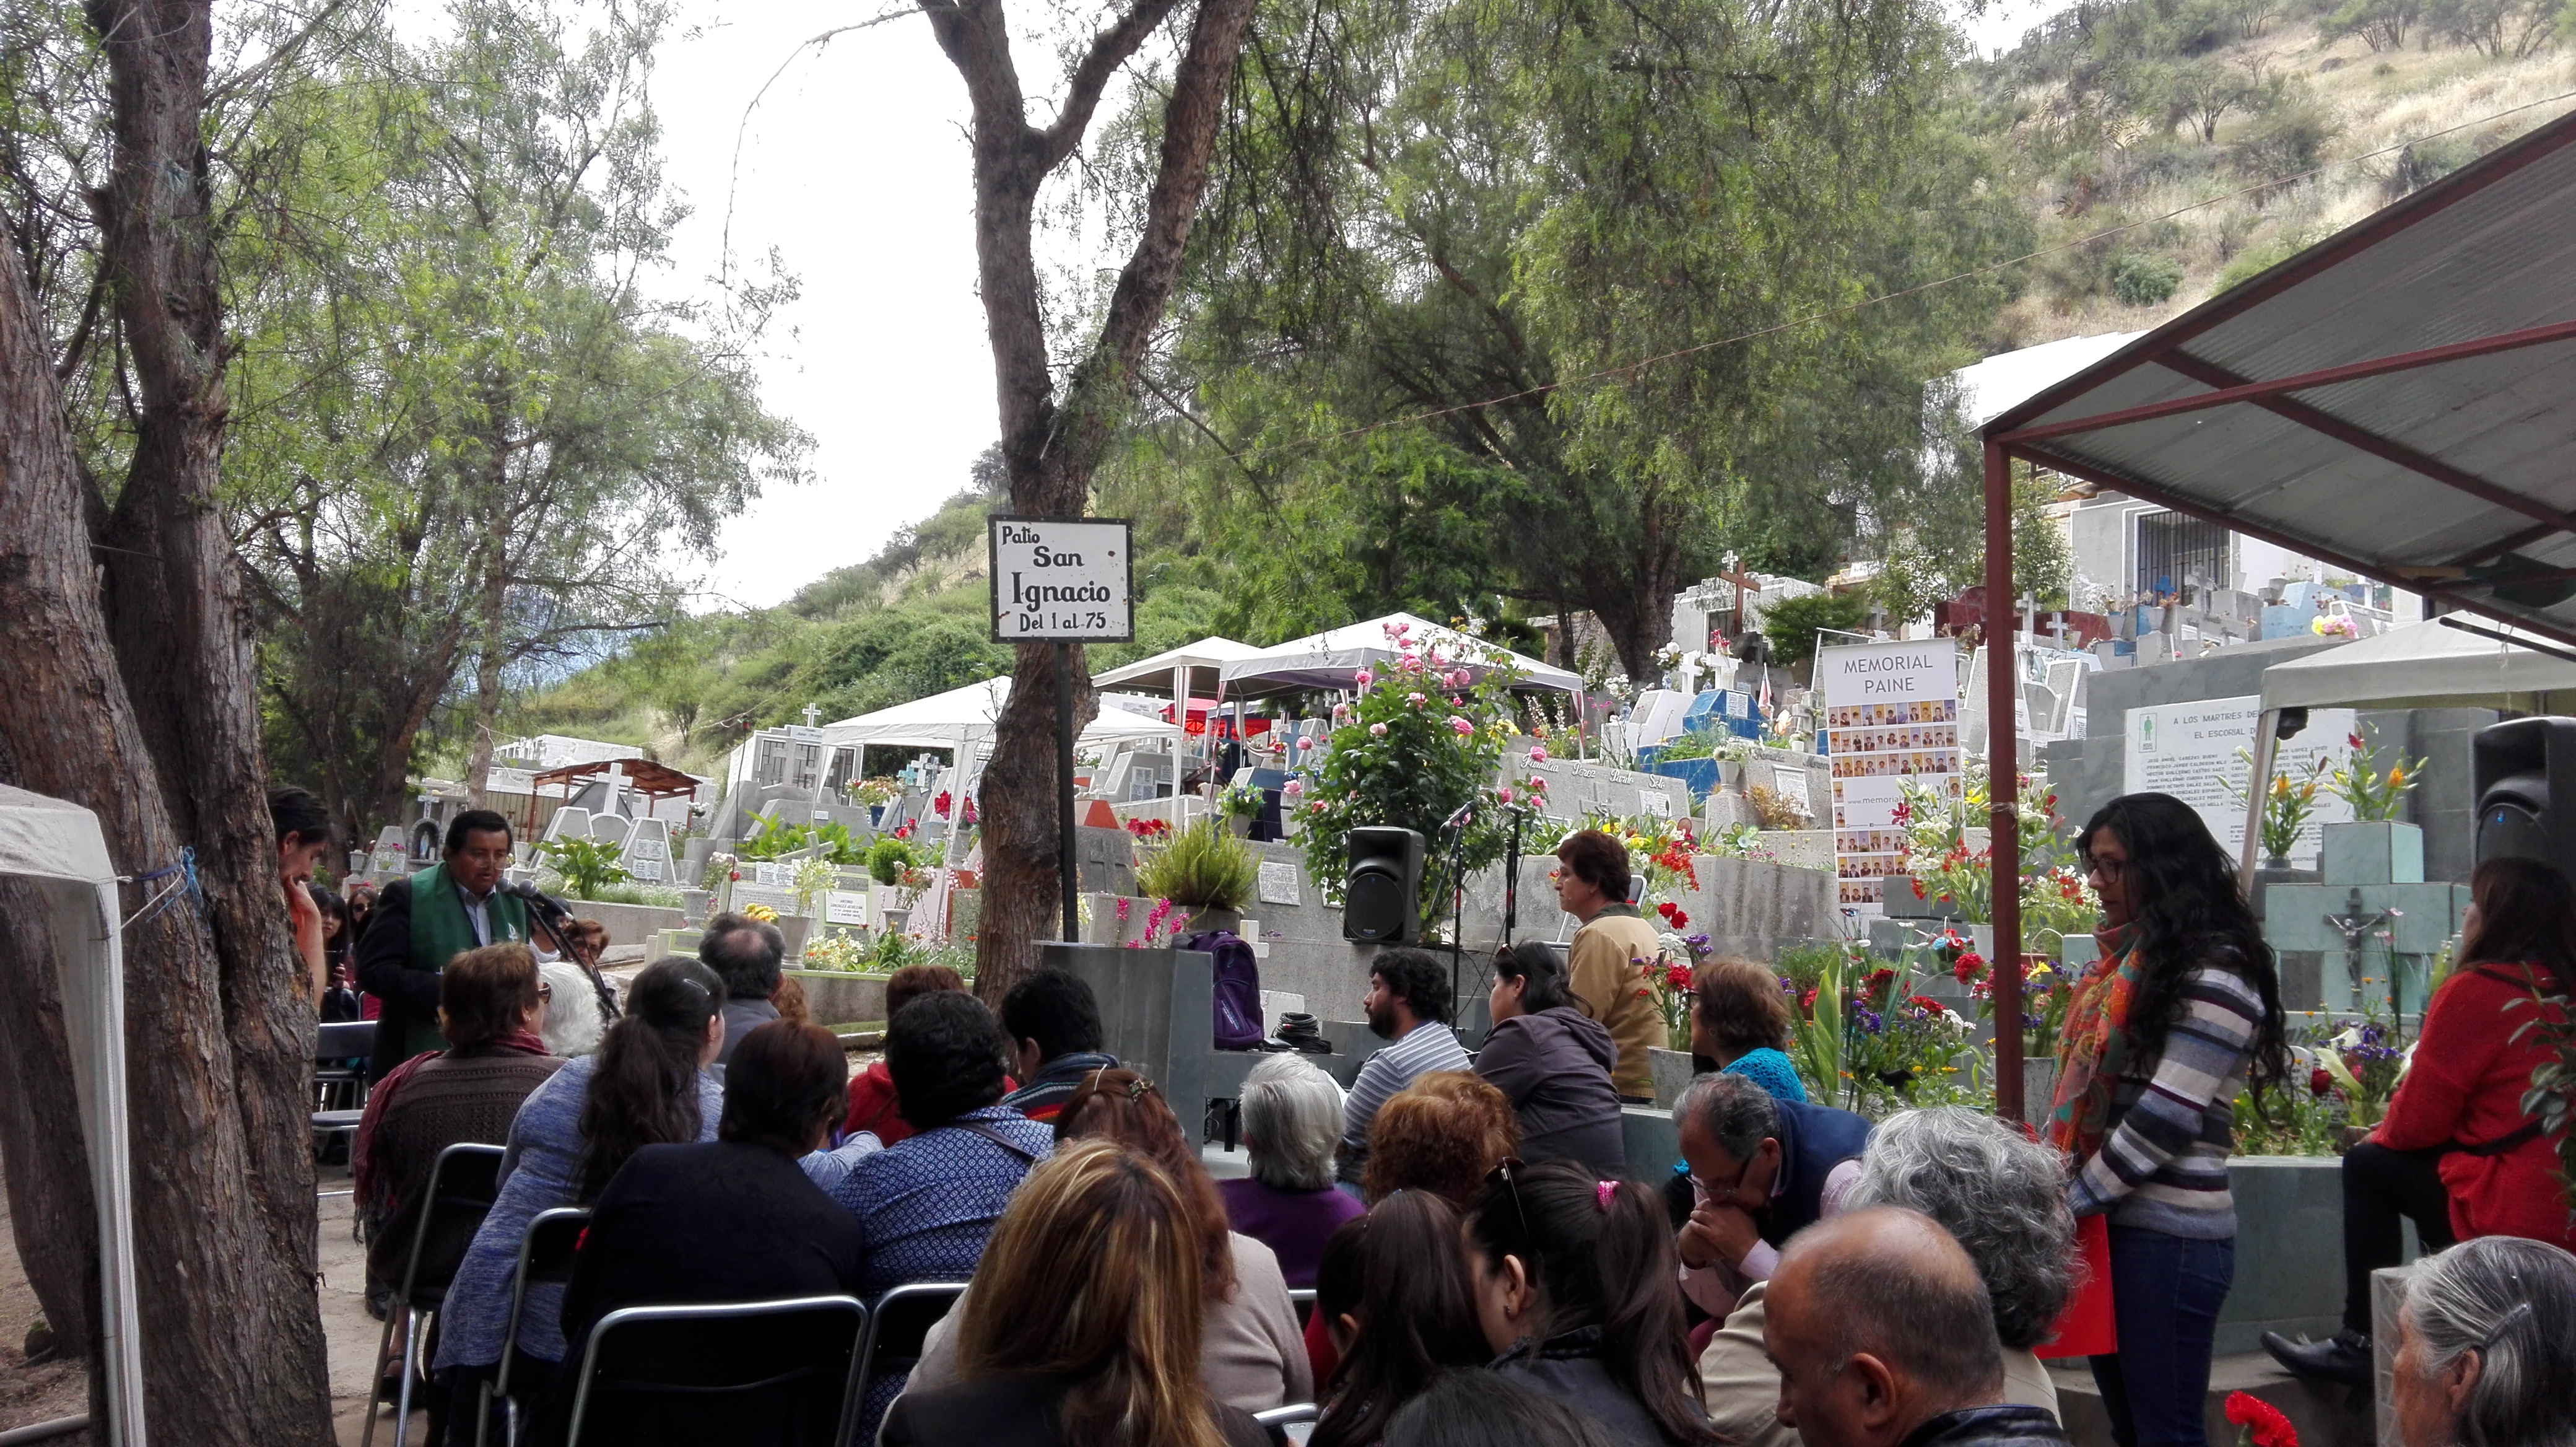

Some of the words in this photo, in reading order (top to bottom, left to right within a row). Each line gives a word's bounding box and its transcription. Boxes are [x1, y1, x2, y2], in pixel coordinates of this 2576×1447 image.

[1002, 525, 1040, 545] Patio
[1033, 545, 1085, 567] San
[1011, 572, 1110, 613] Ignacio
[1019, 613, 1043, 632] Del
[1051, 612, 1057, 629] 1
[1063, 613, 1080, 629] al
[1086, 612, 1106, 629] 75
[1844, 654, 1933, 674] MEMORIAL
[1865, 677, 1915, 694] PAINE
[2183, 716, 2198, 724] LOS
[2203, 712, 2242, 722] MARTIRES
[2247, 710, 2259, 718] DE
[2208, 729, 2245, 738] ESCORIAL
